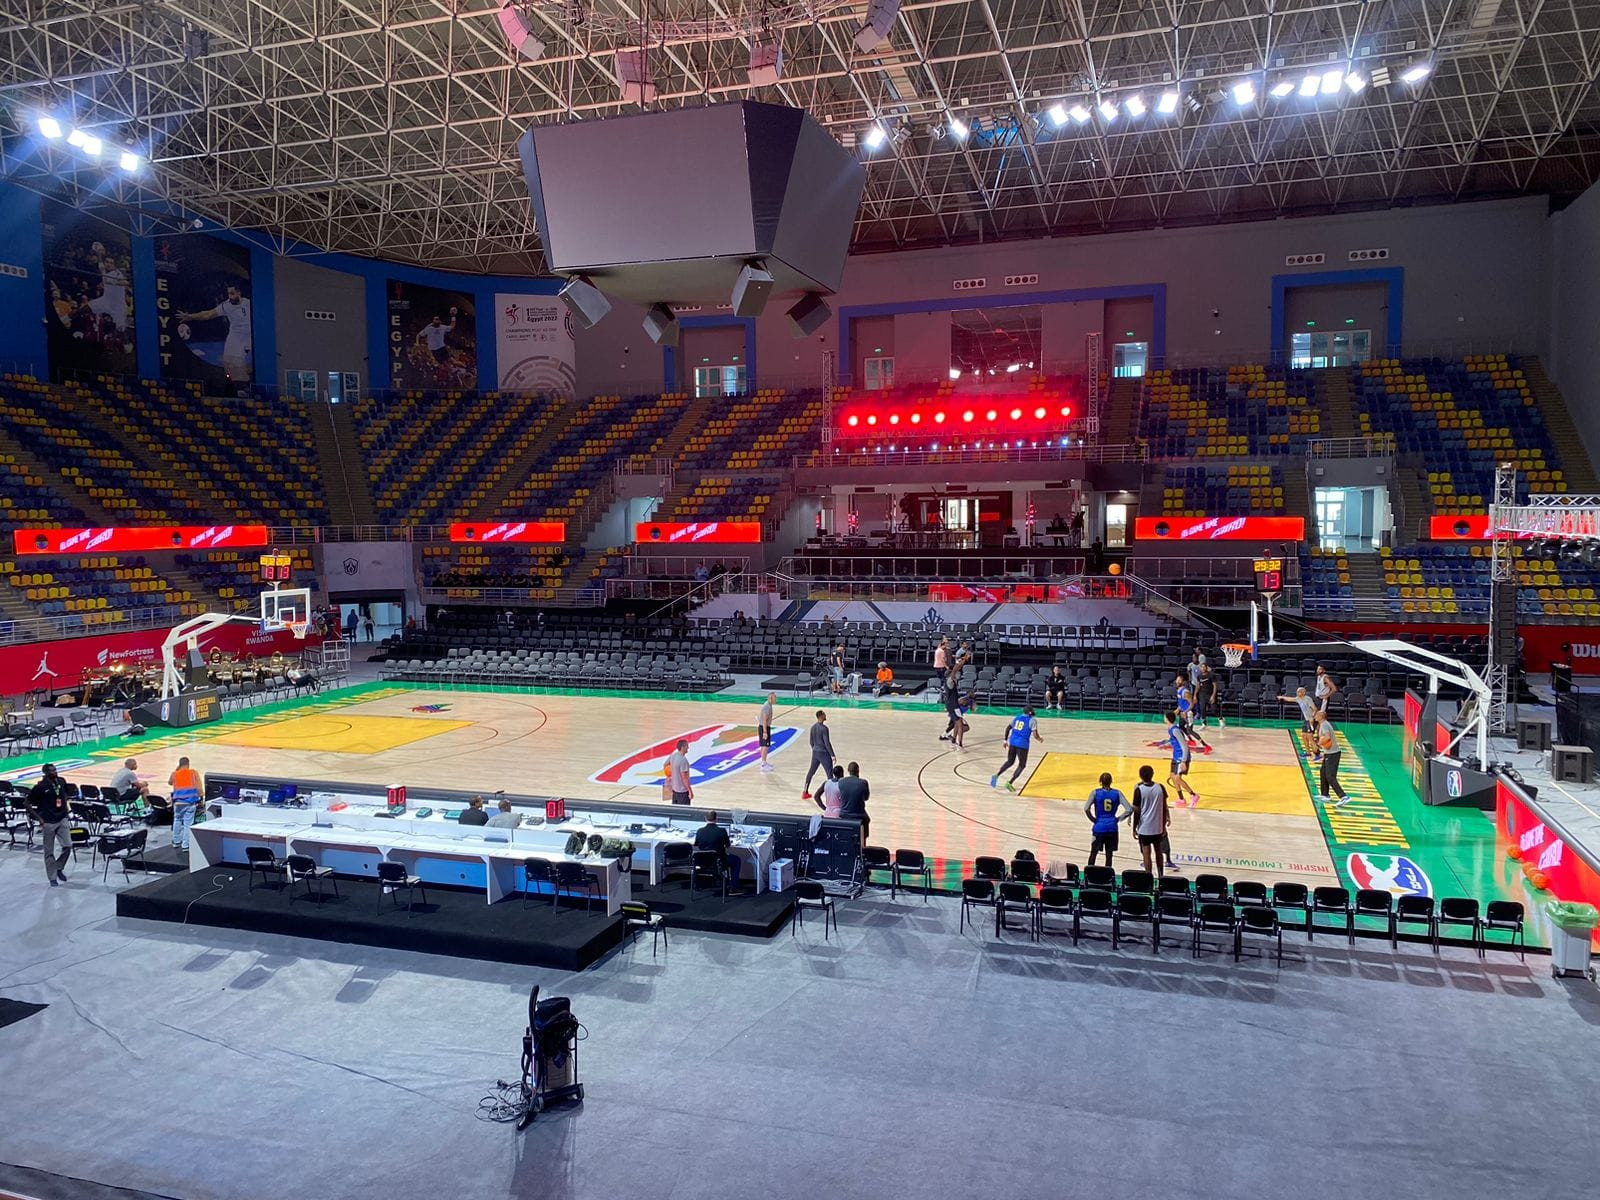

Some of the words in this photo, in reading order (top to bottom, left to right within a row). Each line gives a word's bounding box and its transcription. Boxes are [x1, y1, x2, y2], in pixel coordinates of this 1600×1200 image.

[157, 278, 172, 365] EGYPT
[391, 315, 403, 388] EGYPT
[265, 566, 274, 580] 13
[1263, 572, 1281, 589] 13
[245, 635, 274, 645] RWANDA
[109, 648, 154, 660] NewFortress
[1104, 798, 1112, 812] 6
[1225, 857, 1284, 869] EMPOWER
